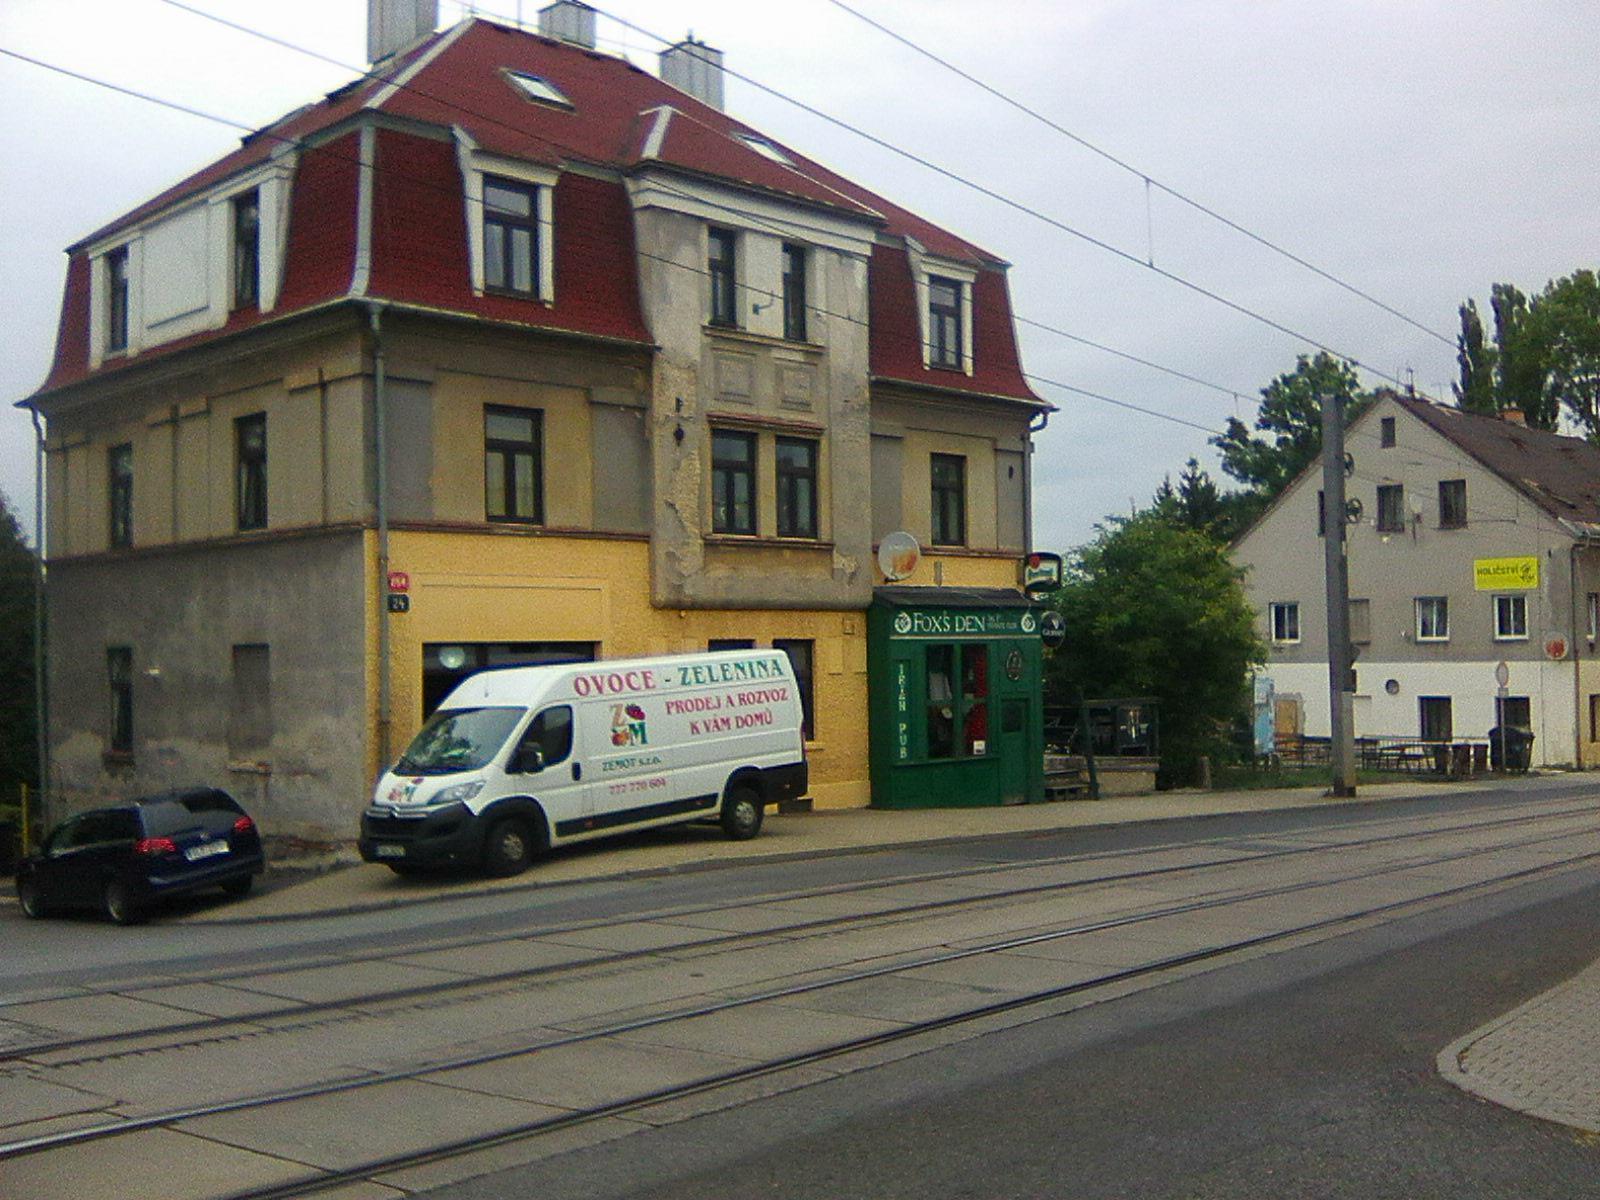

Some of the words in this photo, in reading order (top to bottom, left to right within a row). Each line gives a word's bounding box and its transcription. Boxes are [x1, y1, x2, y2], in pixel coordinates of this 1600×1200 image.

[955, 615, 986, 632] DEN
[573, 670, 656, 697] OVOCE
[678, 658, 786, 687] ZELENINA
[665, 694, 722, 715] PRODEJ
[725, 695, 736, 708] A
[738, 687, 789, 706] ROZVOZ
[689, 720, 701, 735] K
[703, 715, 732, 733] VÁM
